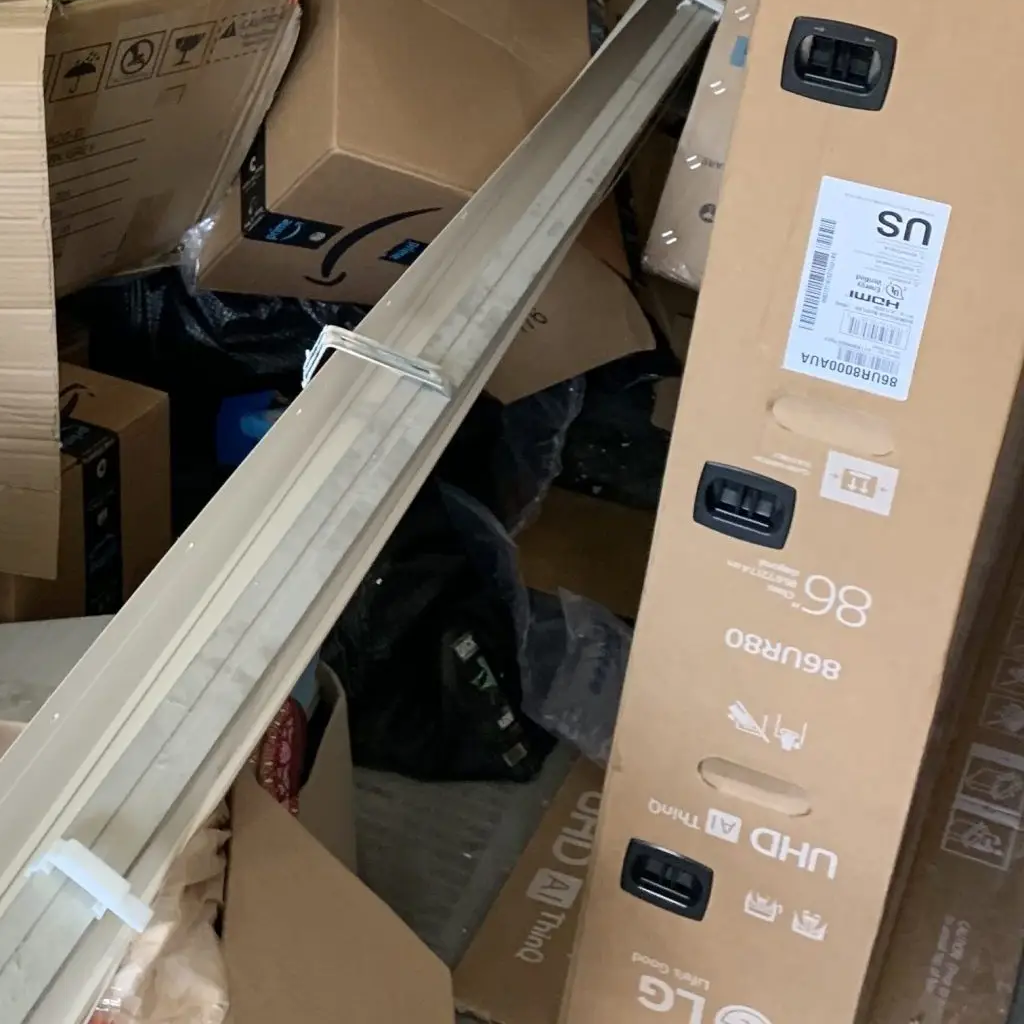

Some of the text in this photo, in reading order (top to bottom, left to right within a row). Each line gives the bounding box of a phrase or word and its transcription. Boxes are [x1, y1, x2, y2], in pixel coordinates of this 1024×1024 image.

[874, 209, 934, 246] US
[798, 350, 899, 388] 86UR8000AUA
[721, 626, 844, 681] 86UR80
[644, 794, 704, 831] ThinQ
[746, 822, 842, 876] UHD
[515, 910, 565, 964] ThinQ
[630, 949, 712, 989] Life's Good
[633, 974, 708, 1024] LG
